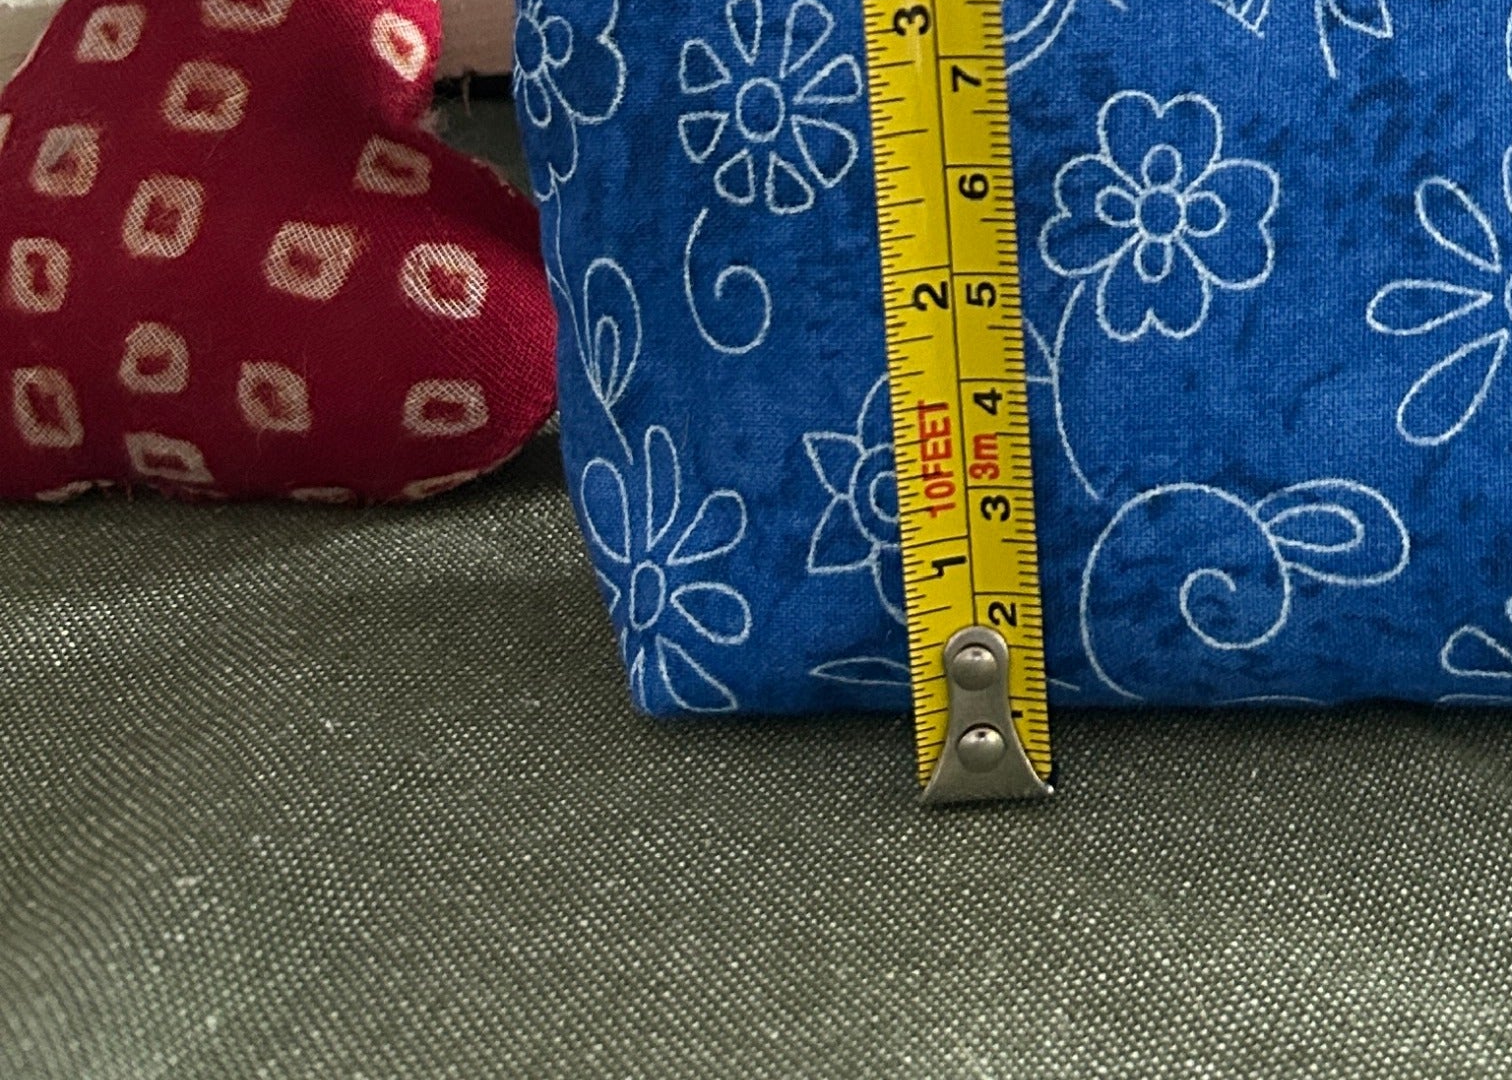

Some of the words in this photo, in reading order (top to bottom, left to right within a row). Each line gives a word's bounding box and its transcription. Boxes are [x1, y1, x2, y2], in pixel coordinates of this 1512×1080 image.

[893, 4, 931, 37] 3
[951, 65, 982, 93] 7
[958, 173, 990, 201] 6
[912, 280, 950, 311] 2
[966, 281, 998, 308] 5
[973, 387, 1003, 416] 4
[917, 399, 958, 519] 10FEET
[968, 433, 1001, 481] 3m
[980, 494, 1011, 522] 3
[931, 555, 967, 577] 1
[988, 601, 1018, 628] 2
